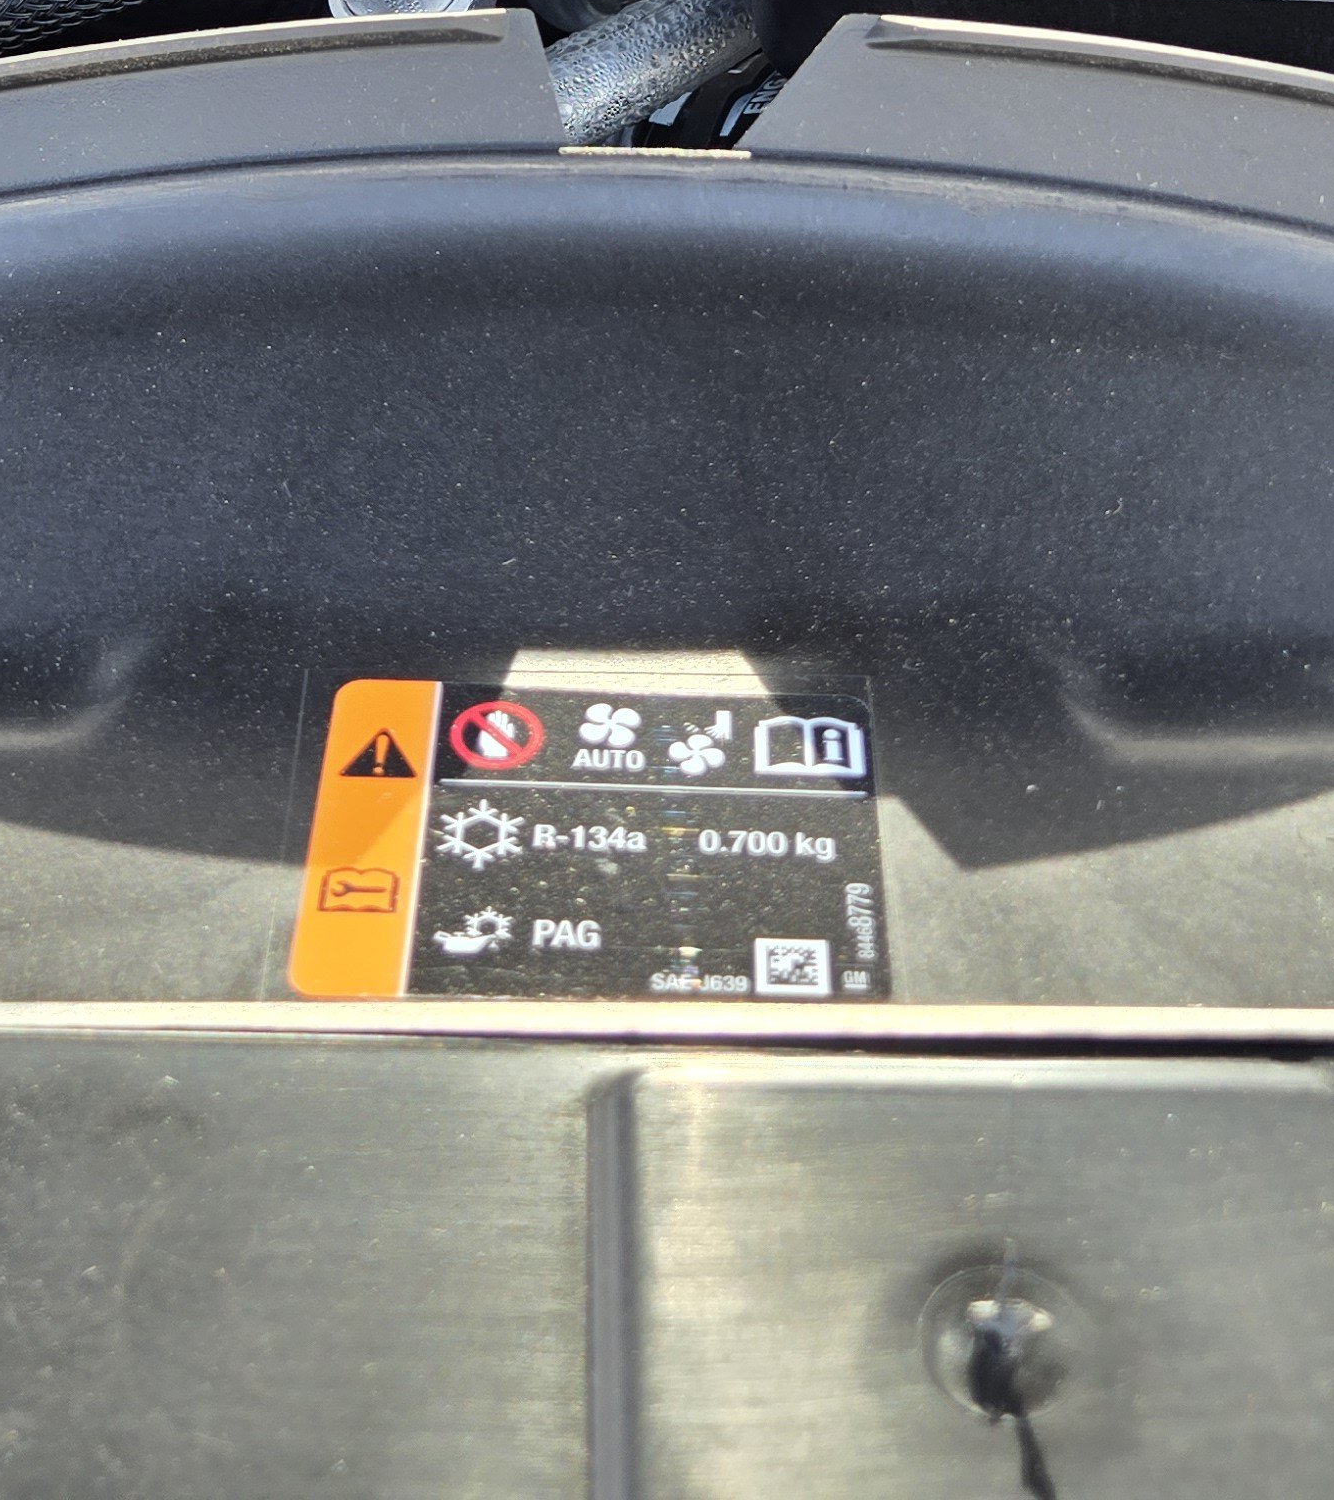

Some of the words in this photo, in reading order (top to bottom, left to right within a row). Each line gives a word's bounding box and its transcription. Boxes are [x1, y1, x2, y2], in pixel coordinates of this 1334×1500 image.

[572, 749, 646, 771] AUTO
[533, 824, 646, 851] R-134a
[698, 829, 788, 856] 0.700
[795, 832, 836, 862] kg
[533, 919, 601, 948] PAG
[650, 973, 692, 991] SAE
[699, 975, 748, 992] J639
[843, 970, 867, 984] GM
